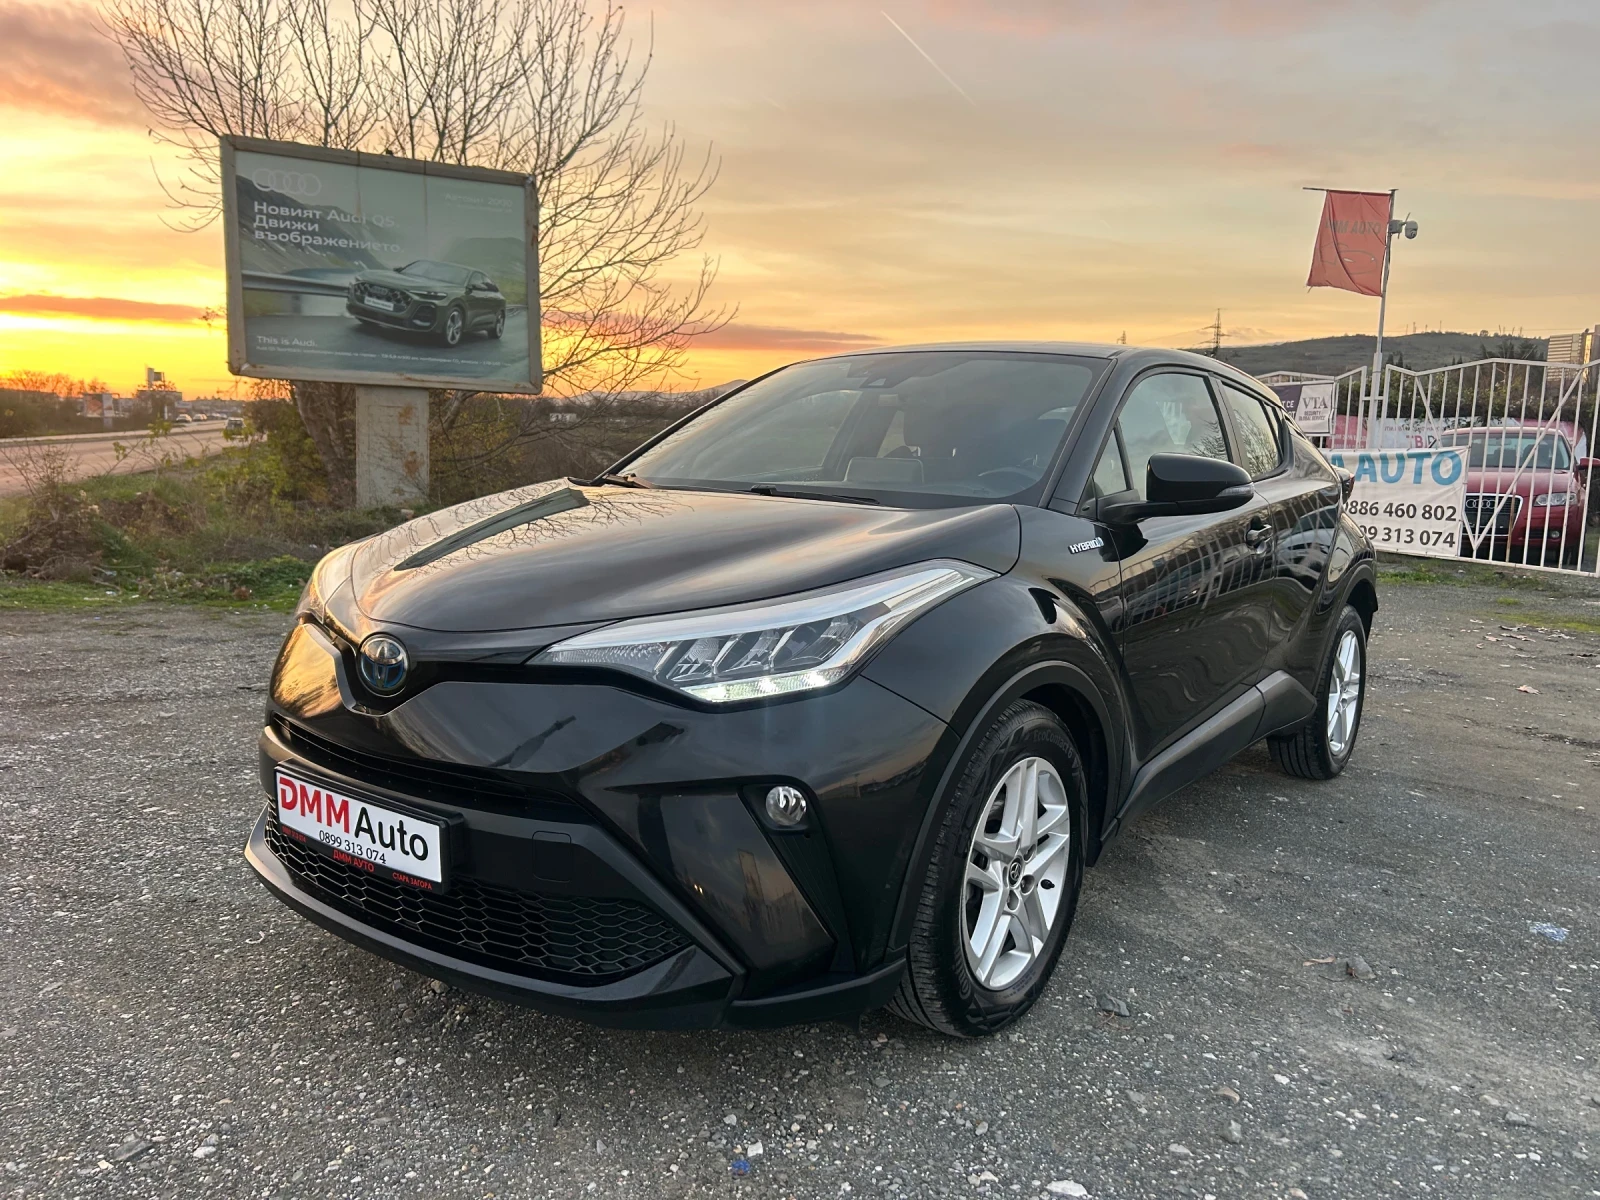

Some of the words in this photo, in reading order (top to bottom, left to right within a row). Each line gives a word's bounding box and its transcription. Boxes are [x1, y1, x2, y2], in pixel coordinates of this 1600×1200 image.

[254, 201, 322, 219] Новият
[327, 210, 366, 225] Audi
[253, 215, 319, 232] Движи
[254, 230, 404, 253] въображението.
[256, 335, 278, 345] This
[281, 336, 290, 346] is
[1302, 396, 1329, 409] VTA
[1354, 451, 1462, 486] AUTO
[1383, 502, 1417, 519] 460
[1421, 504, 1457, 522] 802
[1069, 538, 1101, 553] HYBRID
[1381, 527, 1414, 544] 313
[1420, 530, 1456, 548] 074
[319, 830, 342, 848] 0899
[344, 839, 363, 857] 313
[366, 848, 387, 865] 074
[333, 849, 352, 864] ДММ
[353, 859, 375, 873] АУТО
[392, 871, 409, 883] СТАРА
[410, 877, 433, 891] ЗАГОРА
